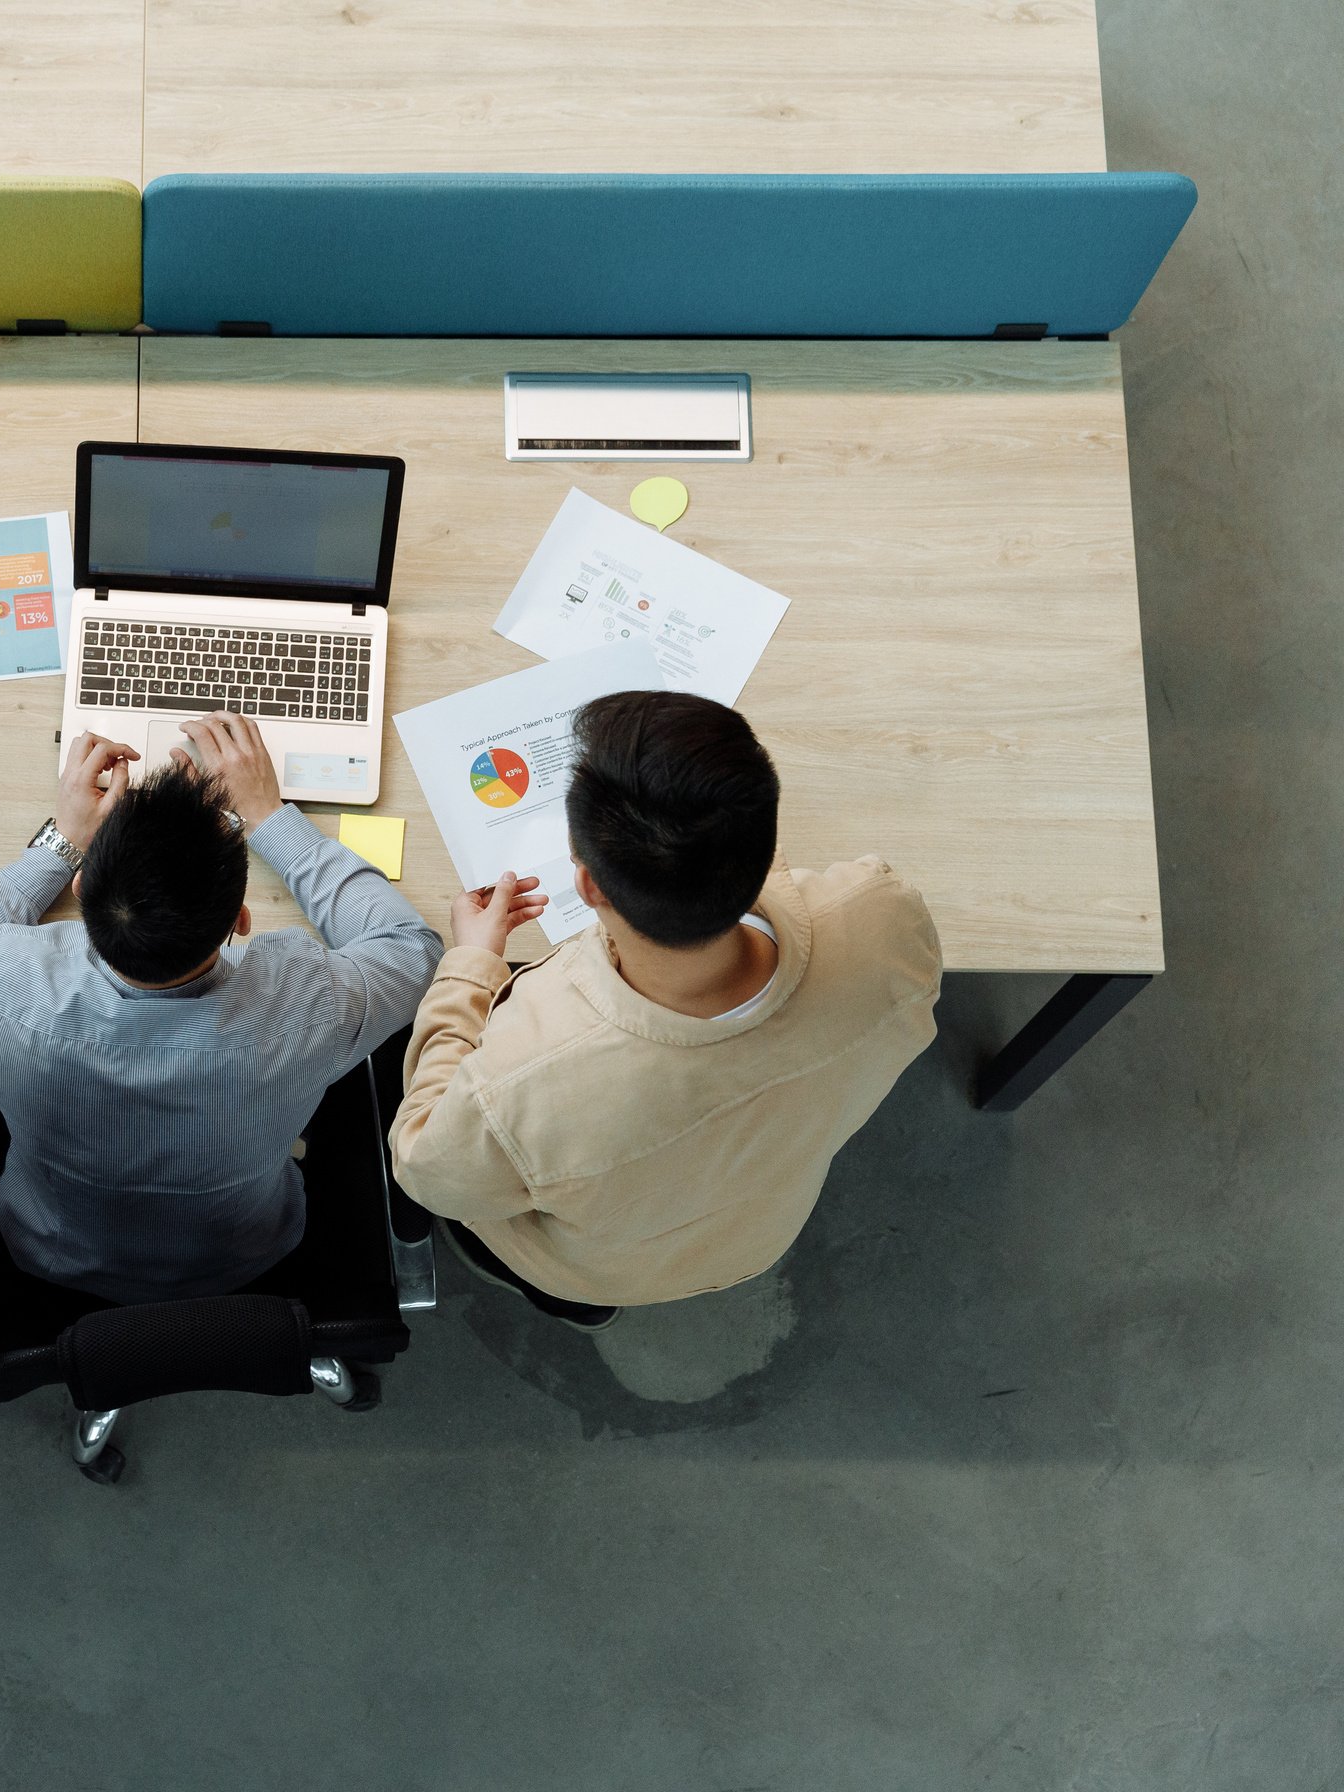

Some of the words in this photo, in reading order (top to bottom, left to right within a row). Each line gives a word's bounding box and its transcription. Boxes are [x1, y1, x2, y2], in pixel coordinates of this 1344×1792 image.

[17, 574, 43, 585] 2017
[21, 612, 48, 624] 13%
[460, 738, 485, 752] Typical
[487, 726, 521, 743] Approach
[522, 719, 543, 730] Taken
[476, 761, 491, 770] 14%
[505, 768, 522, 778] 43%
[473, 777, 488, 786] 12%
[488, 791, 504, 800] 30%
